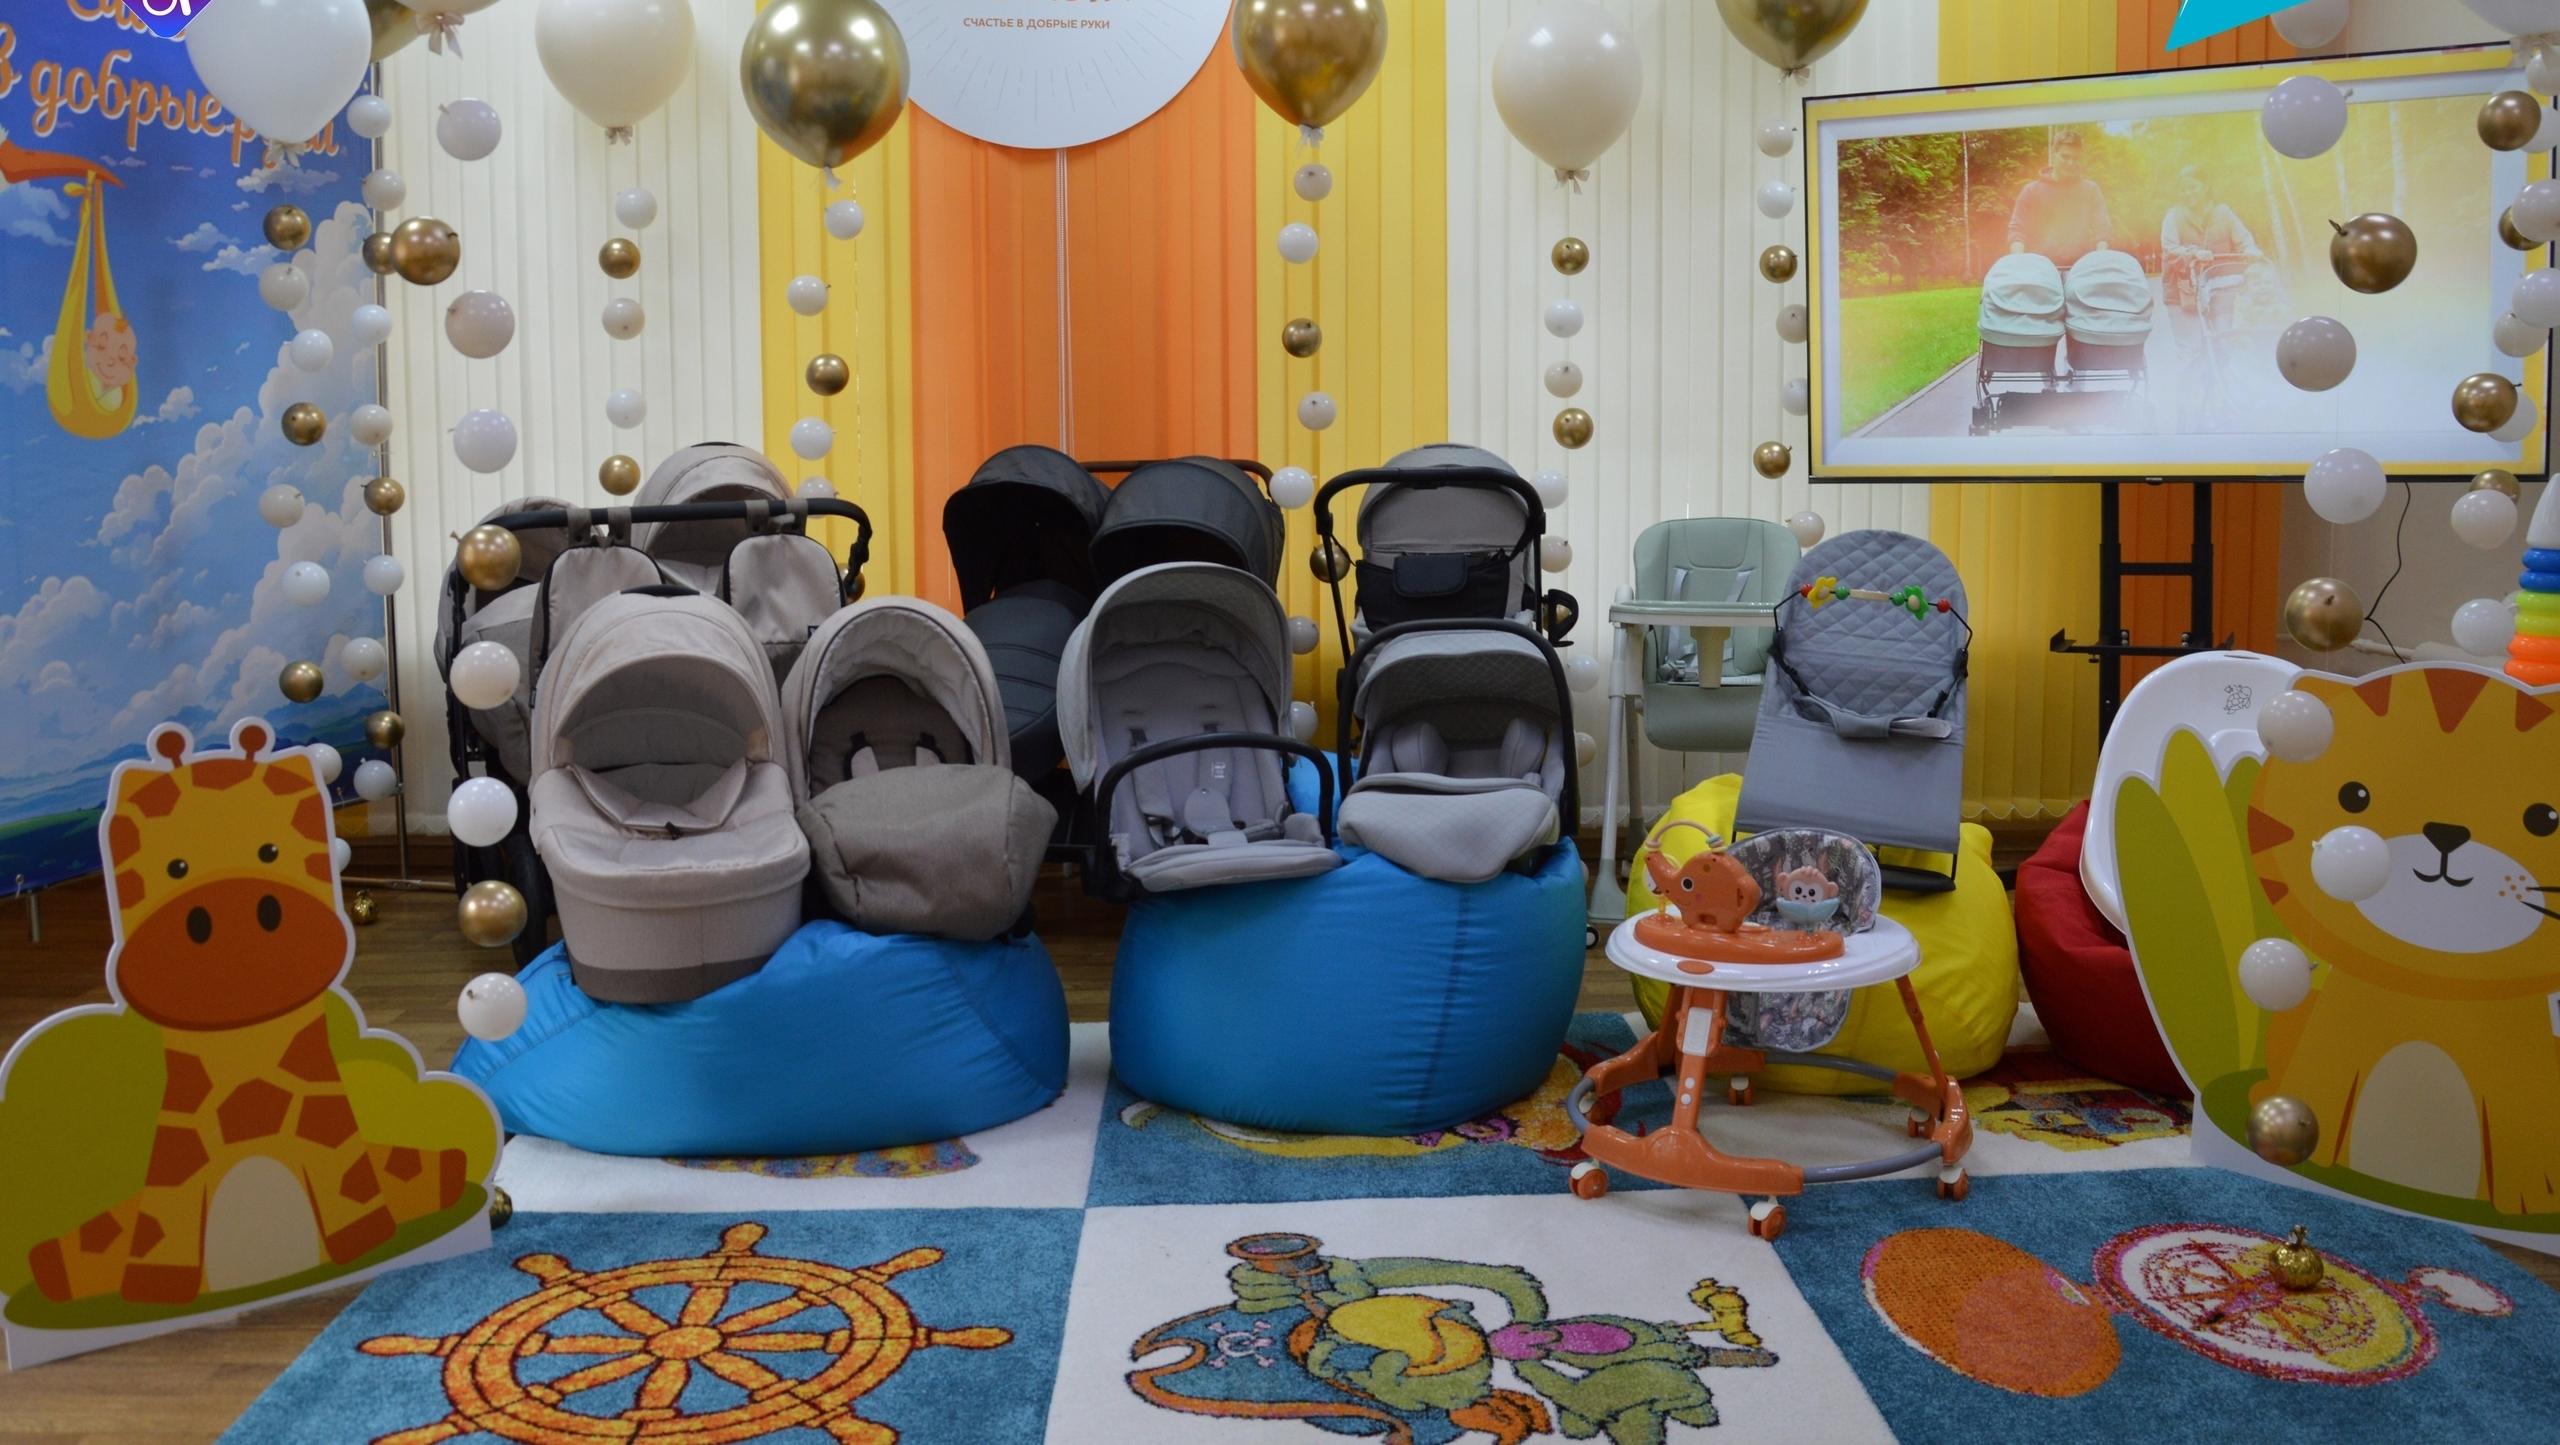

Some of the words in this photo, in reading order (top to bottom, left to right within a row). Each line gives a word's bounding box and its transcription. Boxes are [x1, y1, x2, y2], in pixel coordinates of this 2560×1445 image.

[963, 17, 1015, 28] СЧАСТЬЕ
[1016, 18, 1024, 28] В
[1026, 18, 1078, 30] ДОБРЫЕ
[1080, 19, 1110, 30] РУКИ
[29, 48, 227, 152] добрые
